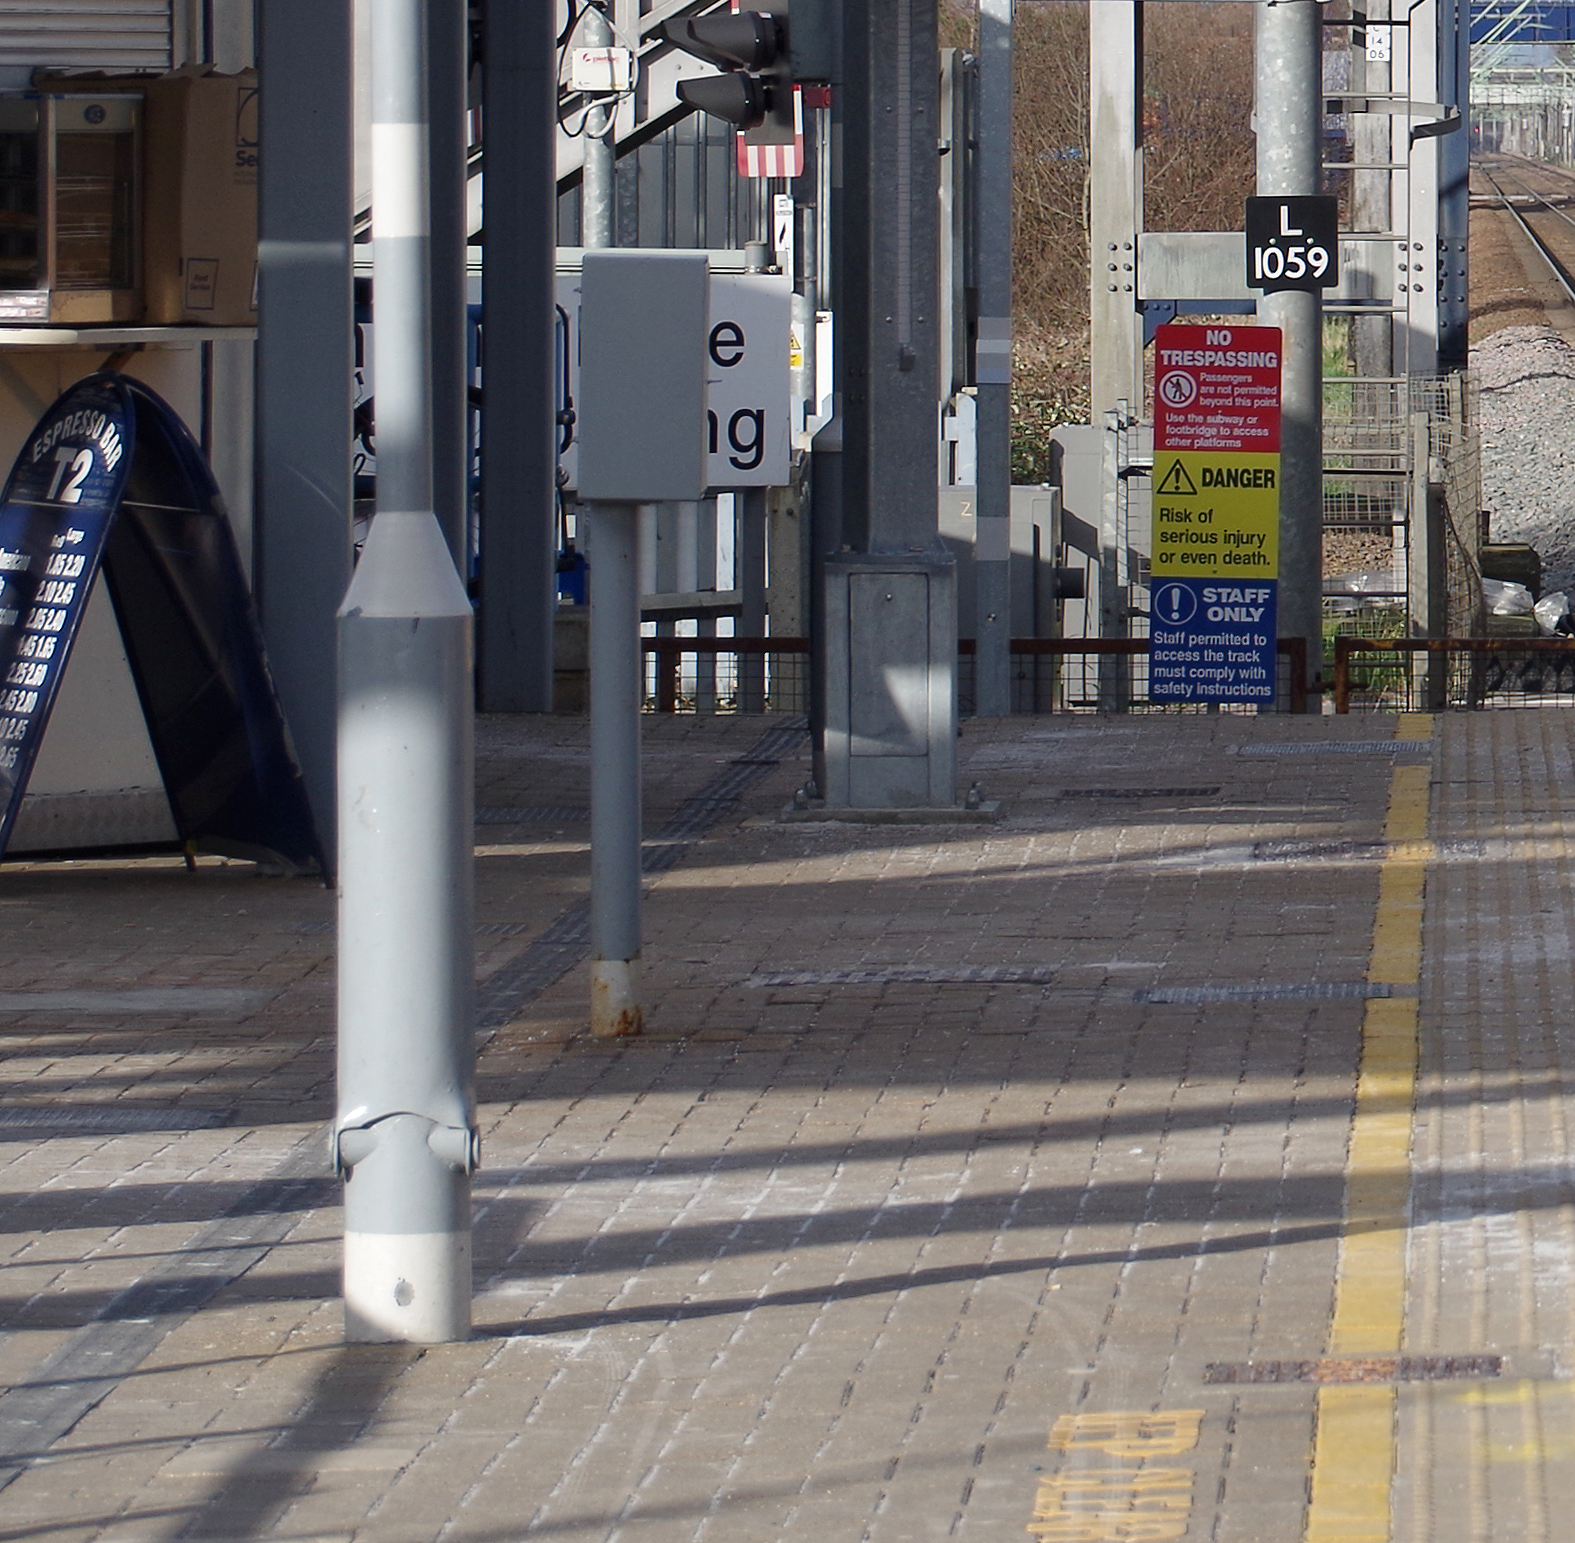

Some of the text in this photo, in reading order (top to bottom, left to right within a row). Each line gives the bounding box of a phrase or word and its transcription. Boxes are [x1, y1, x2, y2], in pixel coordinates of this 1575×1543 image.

[1370, 49, 1385, 59] 06
[1280, 205, 1303, 236] L
[1254, 246, 1329, 279] 1059
[1206, 330, 1232, 346] NO
[1160, 350, 1278, 368] TRESPASSING
[1200, 372, 1253, 385] Passengers
[1200, 385, 1278, 396] are not permitted
[1200, 396, 1279, 409] beyond this point.
[1166, 412, 1258, 426] Use the subway or
[1166, 425, 1269, 437] footbridge to access
[33, 409, 123, 473] ESPRESSO BAR
[1165, 437, 1242, 449] other platforms
[46, 446, 94, 504] T2
[1202, 467, 1276, 488] DANGER
[1160, 507, 1213, 523] Risk of
[1160, 528, 1266, 549] serious injury
[1159, 550, 1270, 566] or even death.
[1202, 587, 1271, 603] STAFF
[1207, 606, 1265, 622] ONLY
[1154, 631, 1267, 648] Staff permitted to
[1154, 649, 1260, 662] access the track
[1154, 665, 1266, 682] must comply with
[1153, 681, 1271, 697] safety instructions
